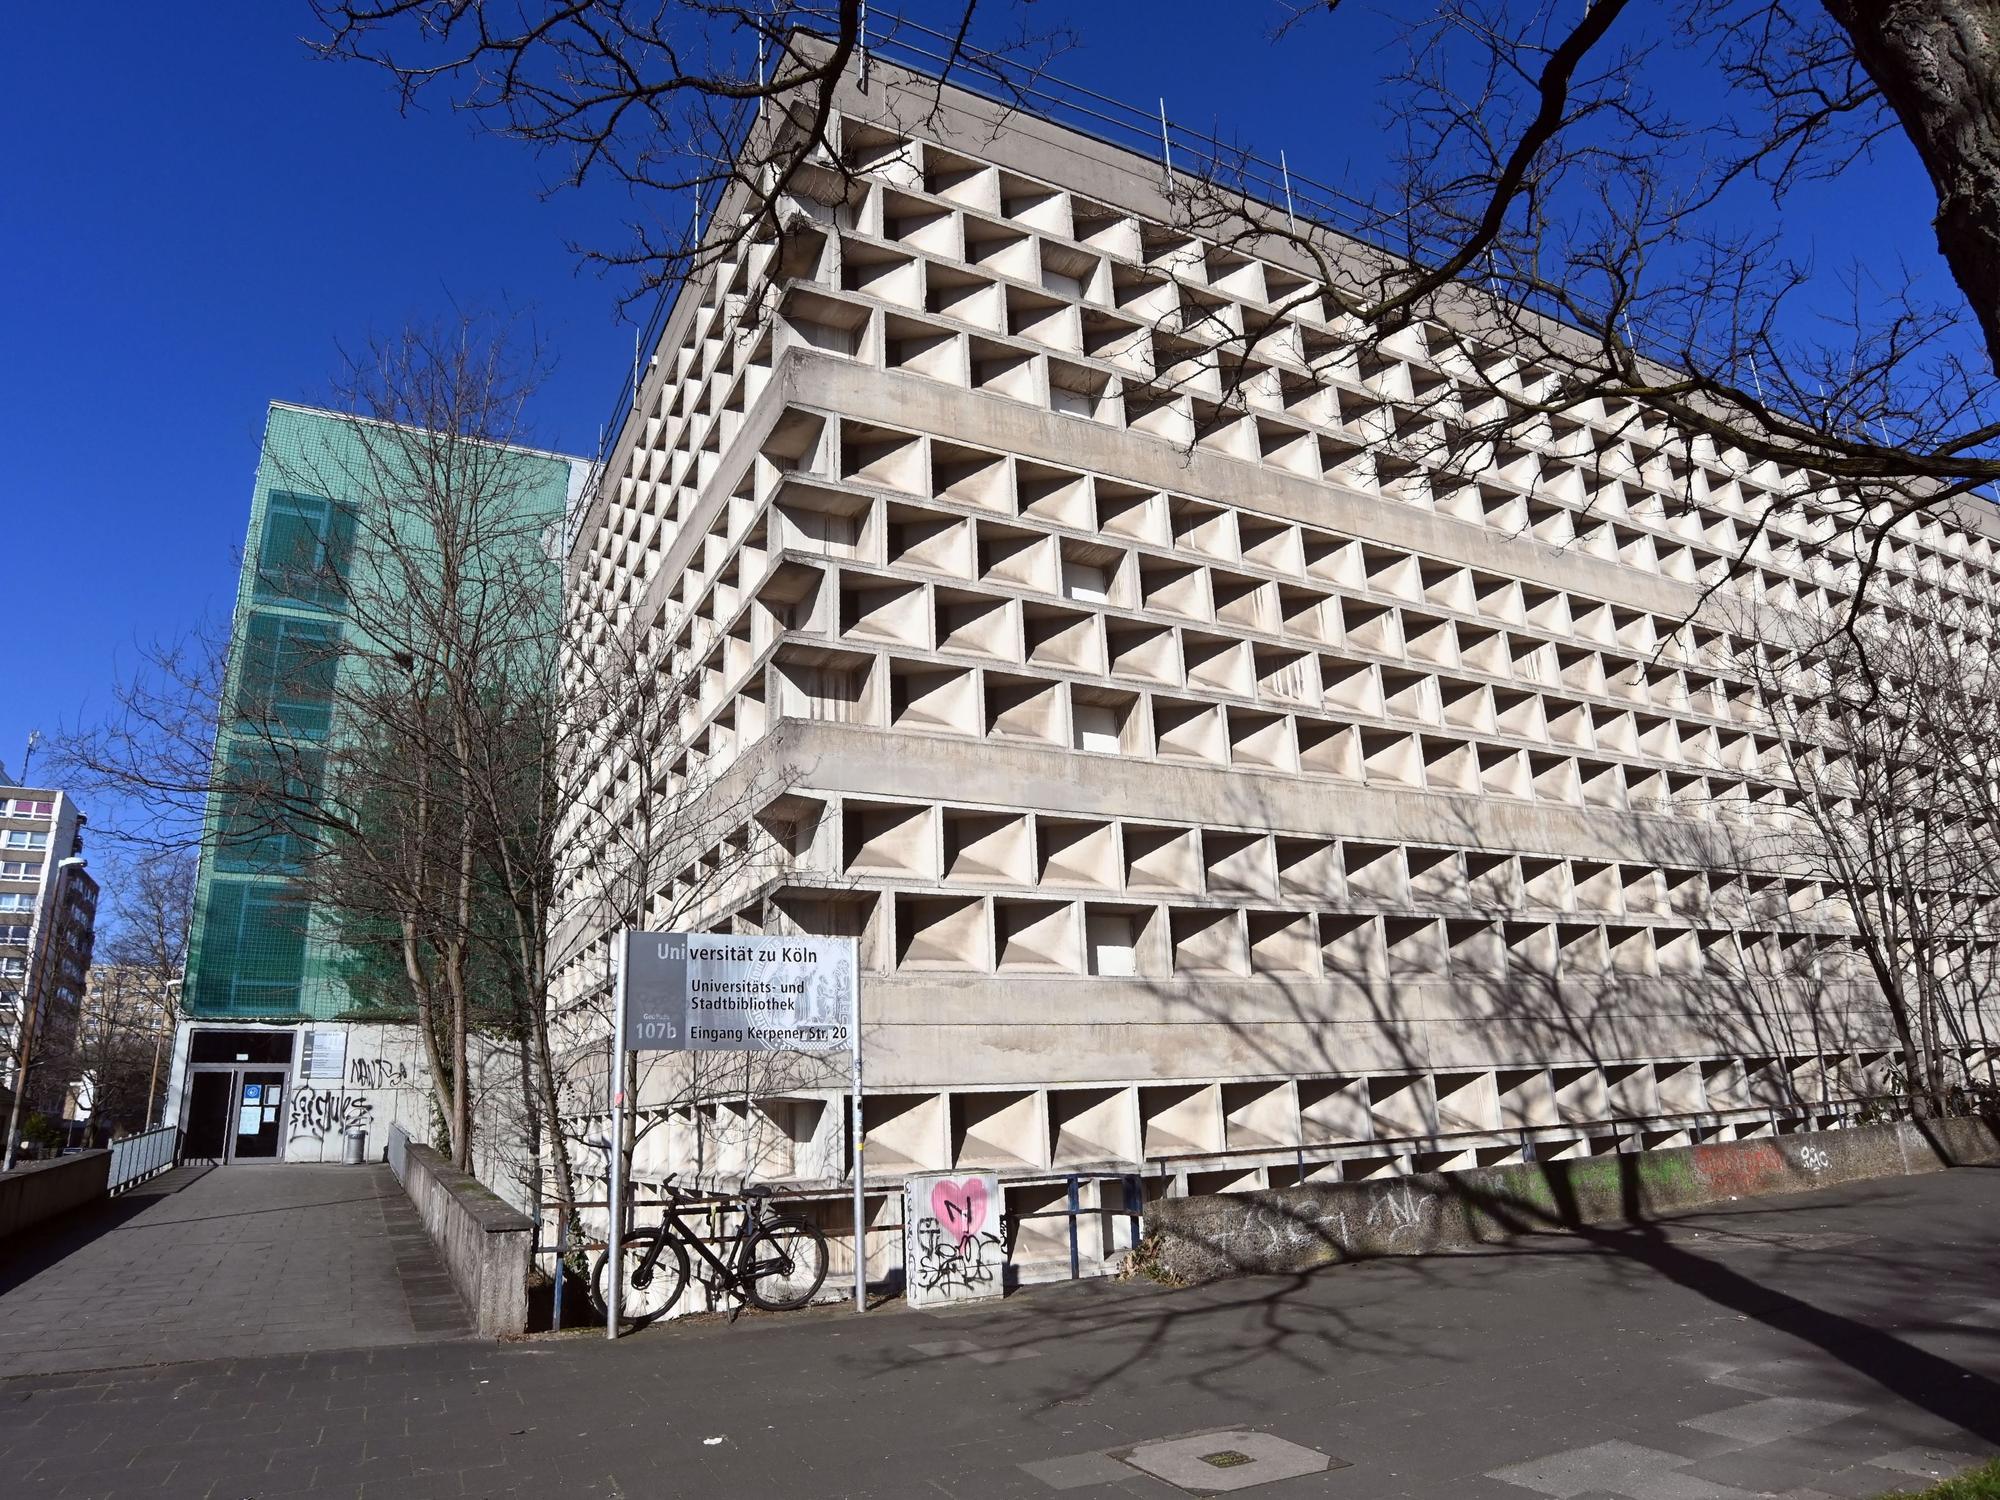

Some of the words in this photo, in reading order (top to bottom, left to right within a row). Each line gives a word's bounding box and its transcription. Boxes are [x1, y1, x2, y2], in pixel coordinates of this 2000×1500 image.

[657, 943, 753, 962] Universität
[758, 950, 776, 962] zu
[782, 947, 817, 963] Köln
[691, 979, 776, 993] Universitäts-
[781, 981, 805, 993] und
[691, 997, 795, 1011] Stadtbibliothek
[637, 1022, 677, 1039] 107b
[690, 1026, 742, 1042] Eingang
[747, 1027, 806, 1042] Kerpener
[809, 1026, 828, 1039] Str.
[832, 1026, 847, 1039] 20
